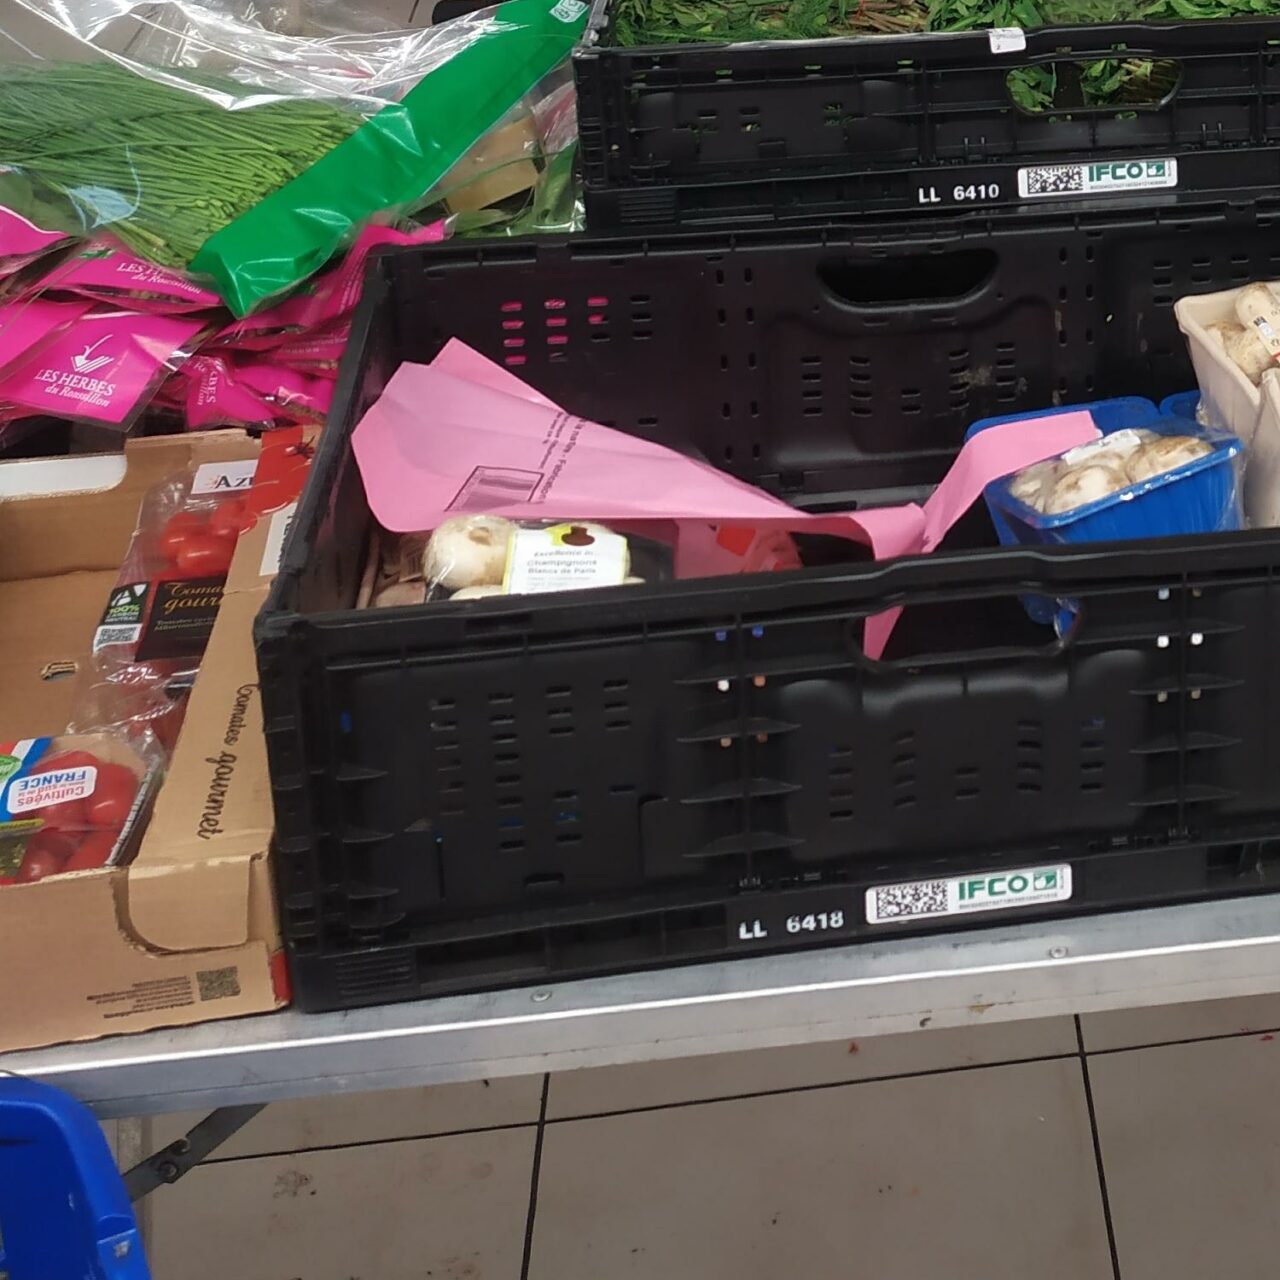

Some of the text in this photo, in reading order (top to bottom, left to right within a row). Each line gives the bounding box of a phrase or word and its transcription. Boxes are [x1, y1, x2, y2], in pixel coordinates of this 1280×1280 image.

[1088, 161, 1144, 183] IFCO
[918, 183, 1000, 204] LL 6410
[34, 369, 116, 396] LES HERBES
[45, 383, 111, 408] du Roussillon
[109, 604, 140, 614] 100%
[20, 770, 87, 791] FRANCE
[17, 785, 85, 807] Cultivées
[197, 751, 238, 840] gourmet
[958, 874, 1029, 902] IFCO
[739, 920, 768, 940] LL
